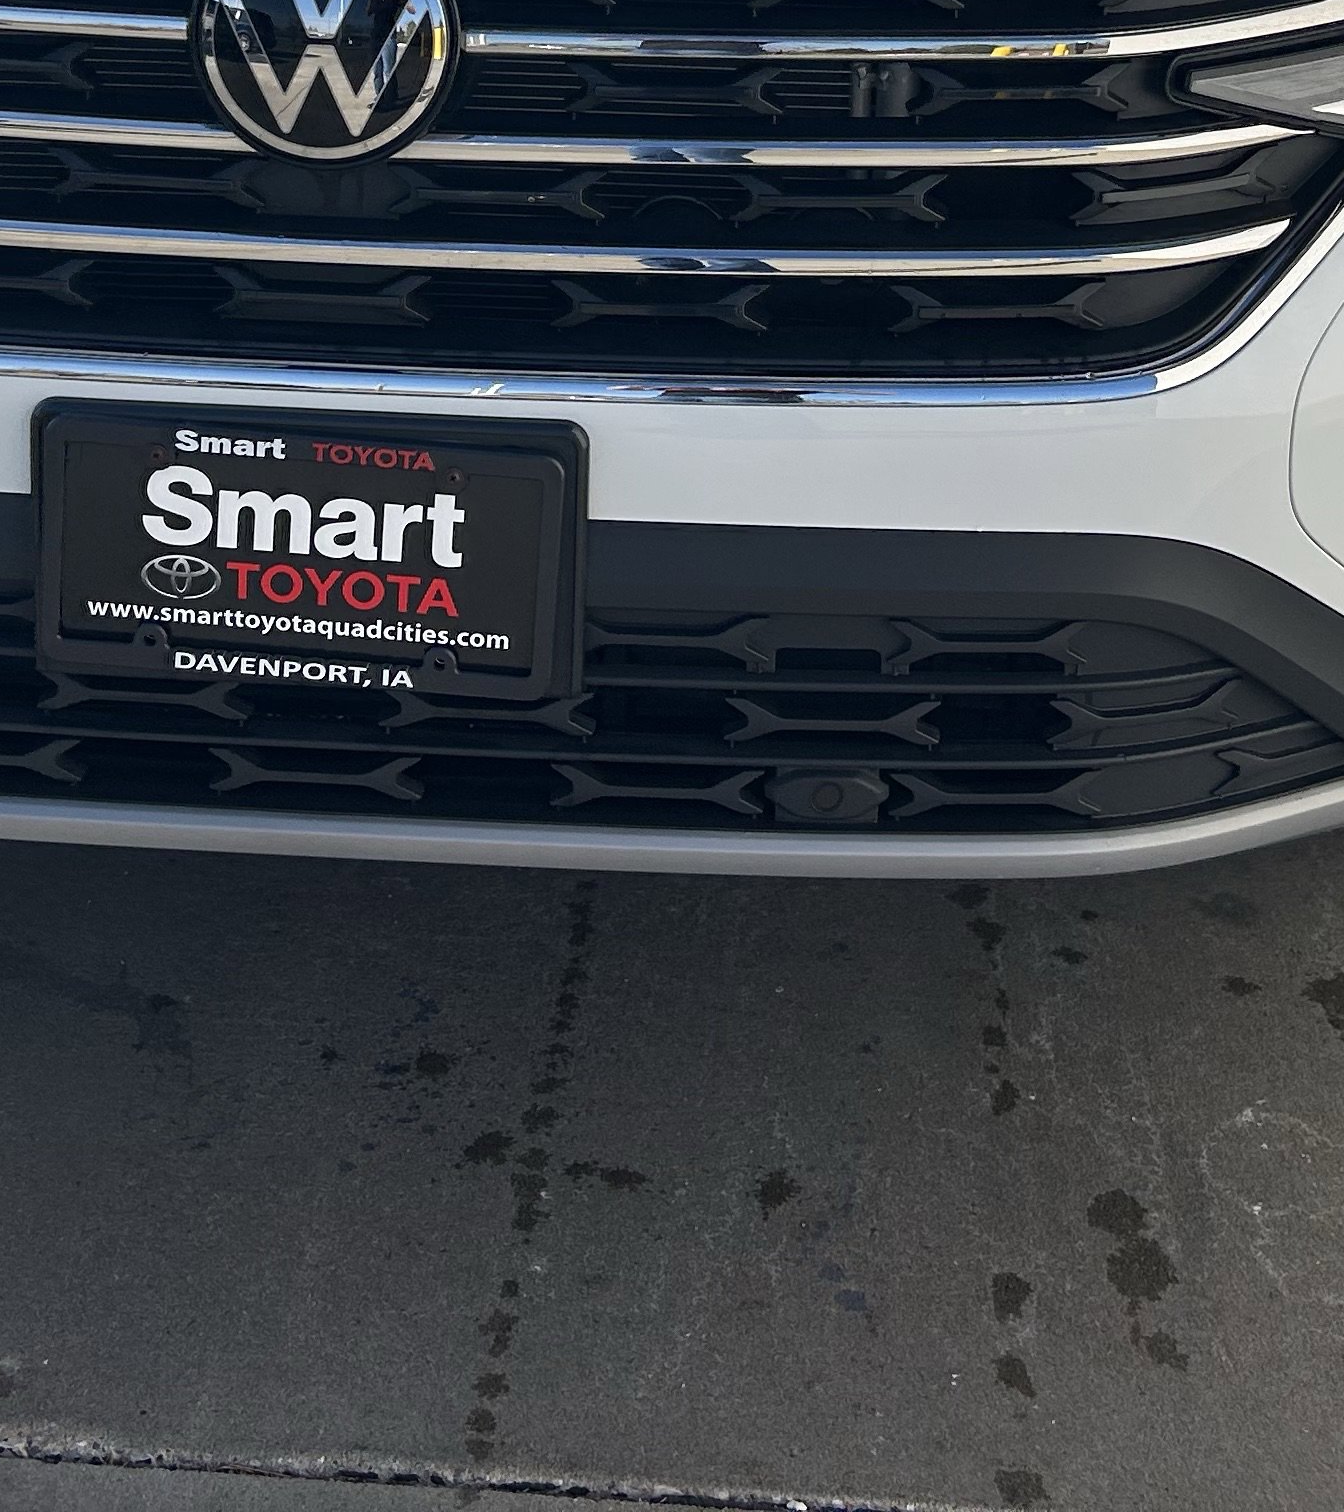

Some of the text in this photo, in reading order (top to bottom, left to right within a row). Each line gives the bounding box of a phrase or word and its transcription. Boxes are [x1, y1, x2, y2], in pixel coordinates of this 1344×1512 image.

[174, 429, 435, 471] Smart TOYOTA
[141, 464, 466, 568] Smart
[226, 561, 459, 617] TOYOTA
[87, 600, 510, 651] www.smarttoyotaquadcities.com
[173, 651, 414, 688] DAVENPORT, IA
